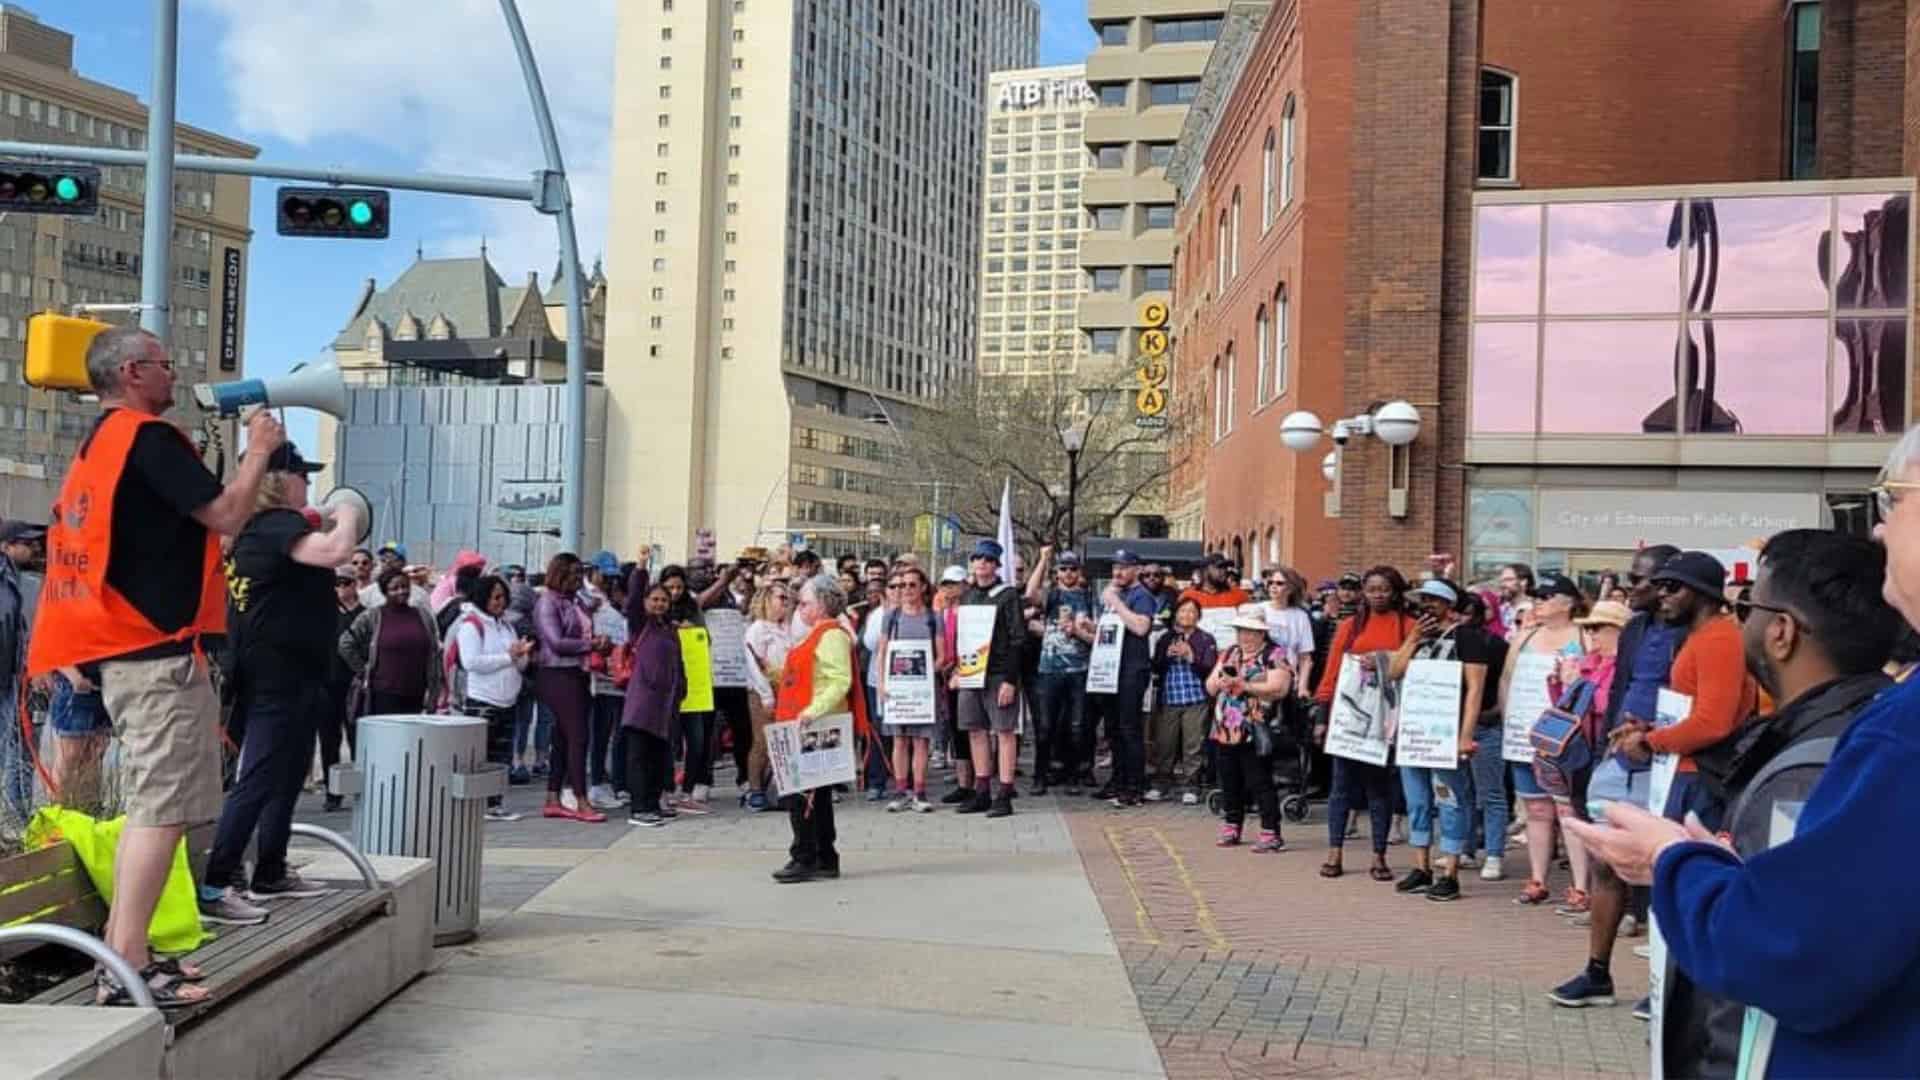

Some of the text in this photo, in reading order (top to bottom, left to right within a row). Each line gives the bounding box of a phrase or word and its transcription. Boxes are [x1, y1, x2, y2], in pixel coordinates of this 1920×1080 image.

[997, 80, 1041, 105] ATB
[224, 253, 238, 359] COURTYARD
[1145, 305, 1161, 409] CKUA
